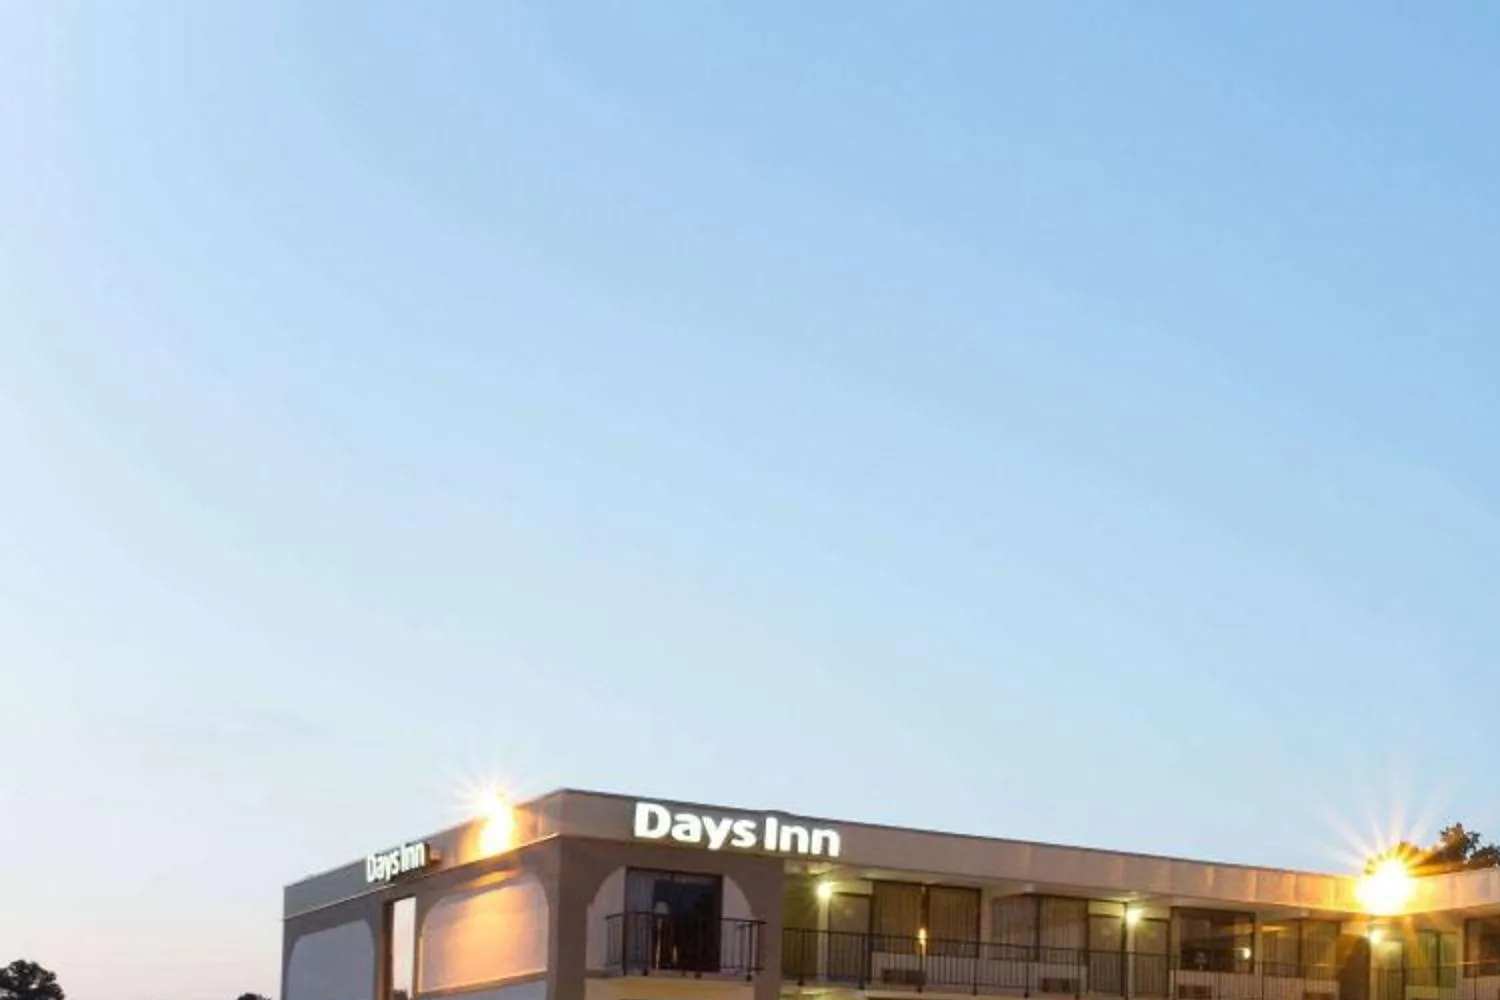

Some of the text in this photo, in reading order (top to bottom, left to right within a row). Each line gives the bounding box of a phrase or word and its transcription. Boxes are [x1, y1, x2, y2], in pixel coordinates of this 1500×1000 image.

[633, 801, 841, 858] Days Inn
[366, 842, 426, 883] Days Inn
